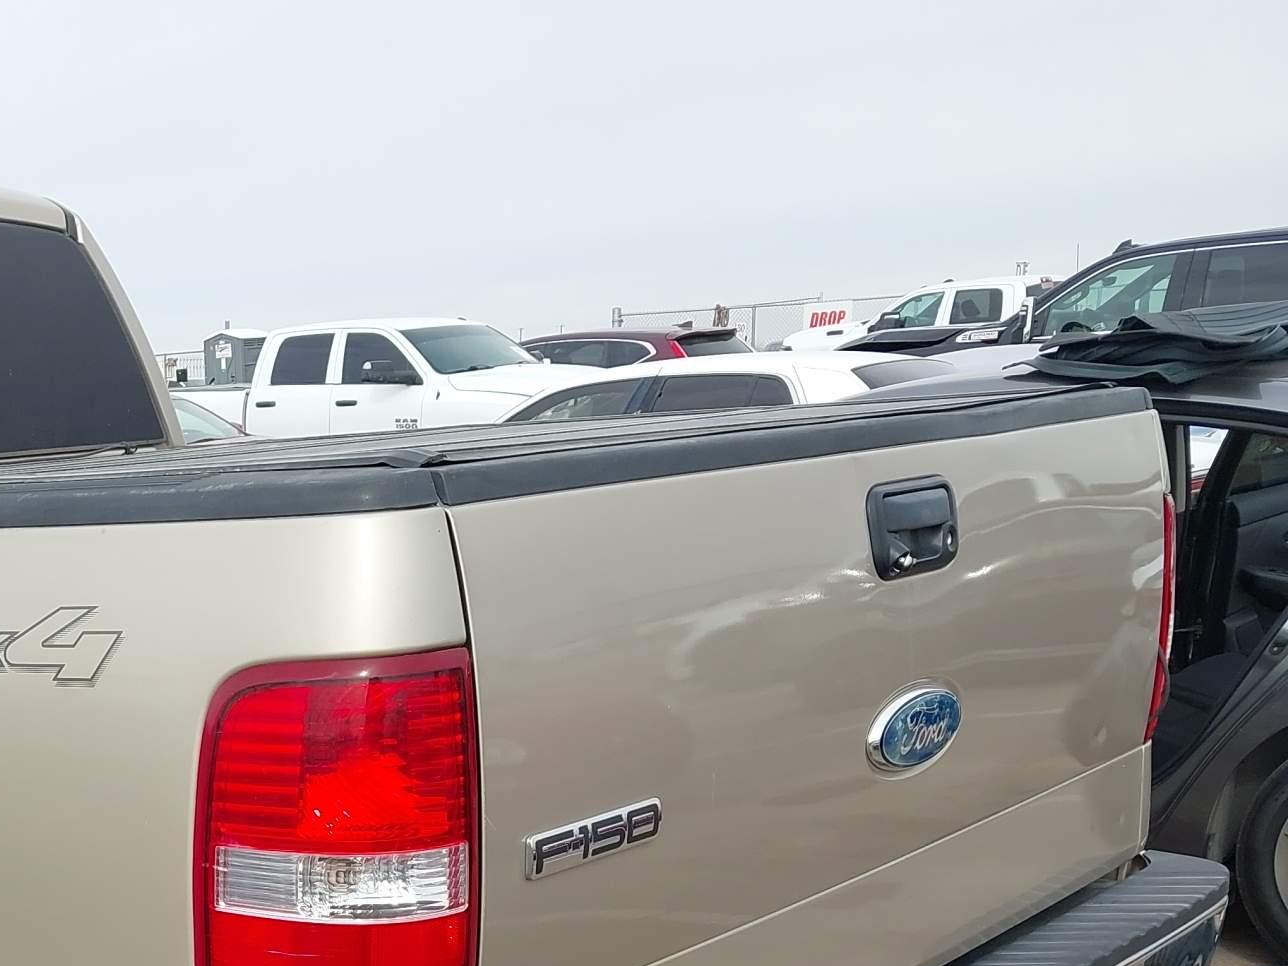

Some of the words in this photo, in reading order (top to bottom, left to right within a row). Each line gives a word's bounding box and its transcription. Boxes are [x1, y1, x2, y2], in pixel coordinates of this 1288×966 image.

[809, 310, 847, 329] DROP
[900, 704, 952, 756] Ford
[534, 802, 661, 875] F-150
